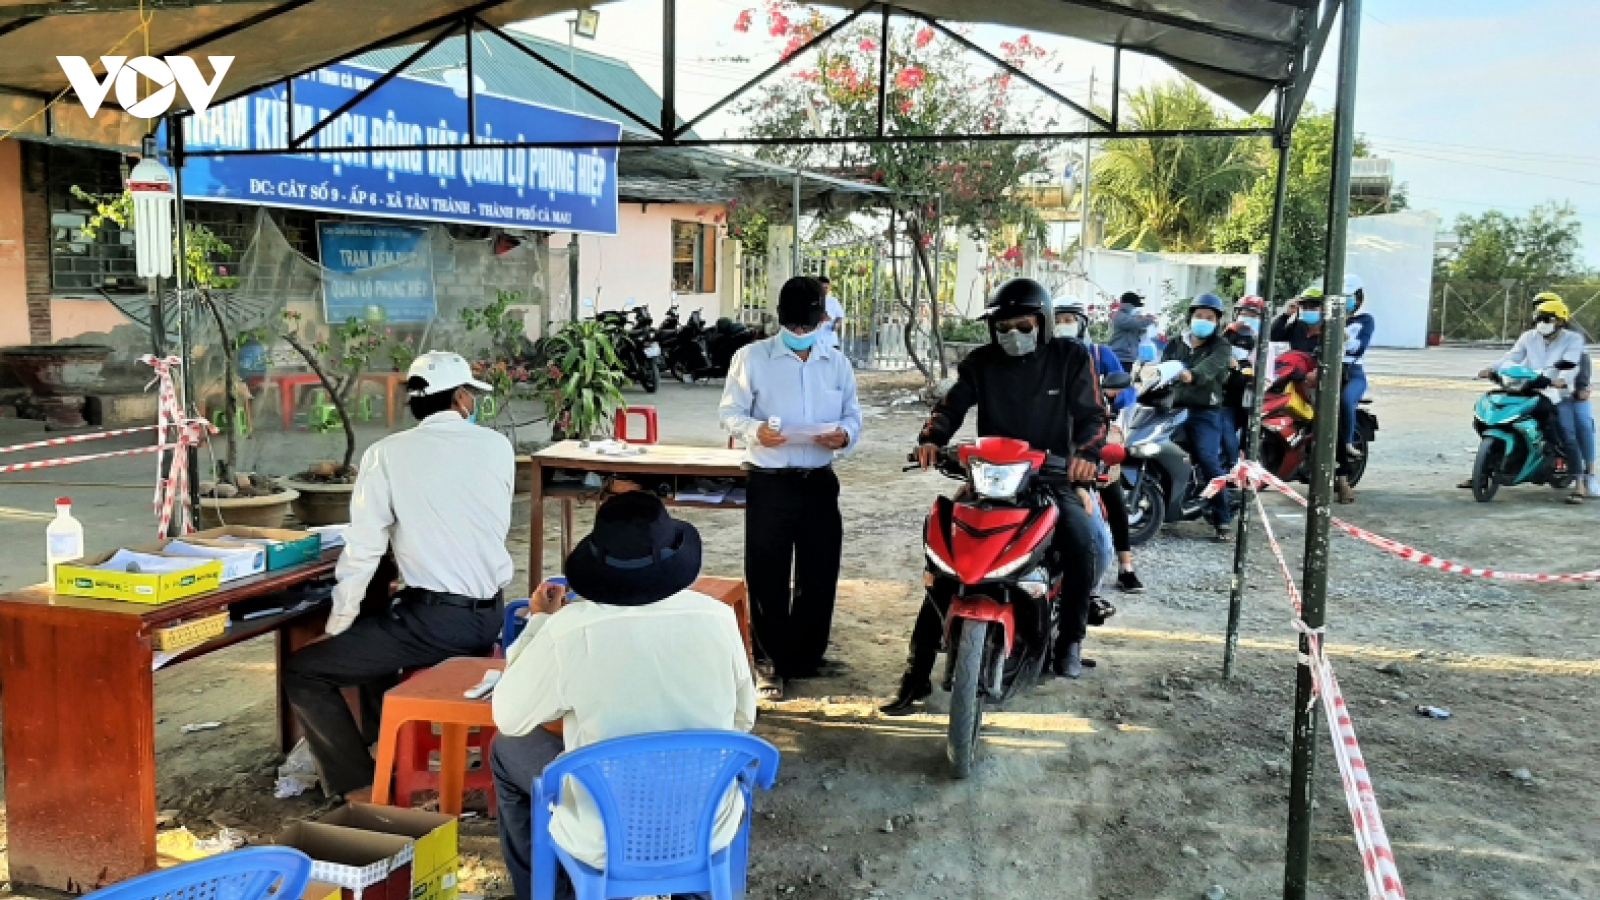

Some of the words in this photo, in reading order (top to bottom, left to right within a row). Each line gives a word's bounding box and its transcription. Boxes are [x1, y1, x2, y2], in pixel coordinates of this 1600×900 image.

[355, 76, 376, 92] MA
[372, 109, 423, 183] ĐỘNG
[426, 119, 458, 188] VẬT
[507, 133, 526, 197] LỘ
[529, 144, 576, 201] PHỤNG
[577, 146, 607, 206] HIỆP
[278, 178, 307, 198] CÂY
[310, 180, 329, 200] SỐ
[331, 188, 339, 201] 9
[386, 191, 403, 208] XÃ
[405, 192, 429, 211] TÂN
[431, 196, 470, 215] THÀNH
[478, 201, 513, 219] THÀNH
[516, 203, 537, 221] PHỐ
[538, 207, 550, 223] CÀ
[553, 211, 572, 225] MAU
